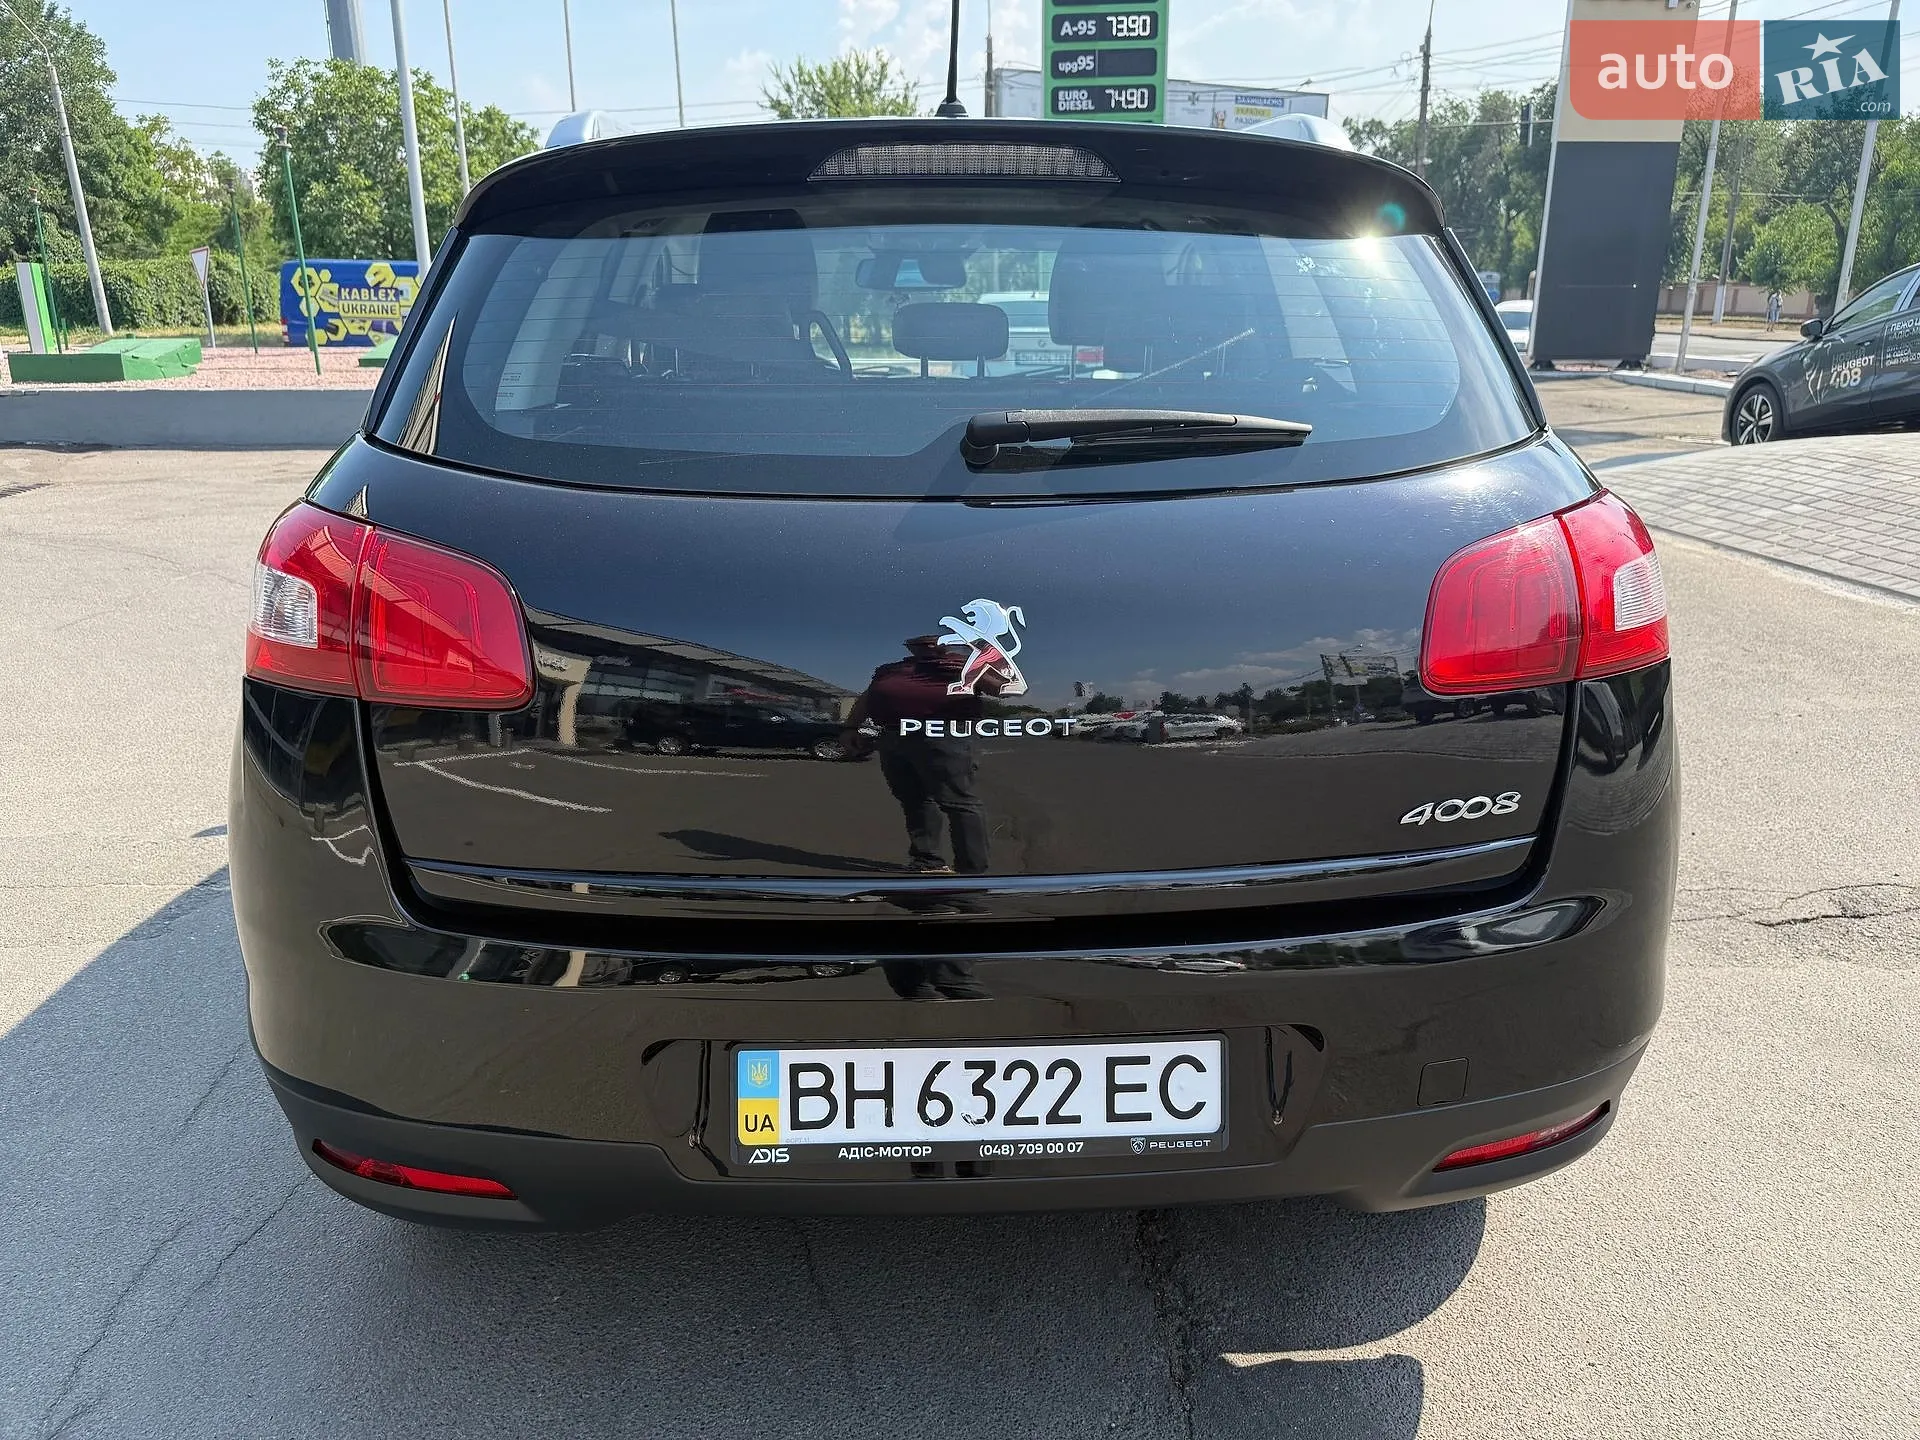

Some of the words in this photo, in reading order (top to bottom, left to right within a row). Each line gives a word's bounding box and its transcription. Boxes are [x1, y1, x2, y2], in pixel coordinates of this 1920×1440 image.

[1060, 20, 1096, 36] A-95
[1058, 55, 1095, 73] upg95
[1058, 90, 1088, 100] EURO
[1058, 100, 1095, 111] DIESEL
[341, 287, 396, 300] KABLEX
[342, 303, 397, 316] UKRAINE
[1831, 355, 1875, 373] PEUGEOT
[1829, 368, 1862, 389] 408
[900, 718, 1077, 738] PEUGEOT
[1400, 791, 1522, 826] 4008
[789, 1060, 894, 1131] BH
[917, 1057, 1082, 1127] 6322
[1105, 1054, 1207, 1123] EC
[744, 1114, 775, 1132] UA
[978, 1143, 1015, 1157] (048)
[1018, 1142, 1043, 1155] 709
[1046, 1142, 1063, 1154] 00
[1068, 1141, 1084, 1153] 07
[1149, 1139, 1212, 1149] PEUGEOT
[748, 1147, 790, 1164] ADIS
[838, 1145, 932, 1160] АДІС-МОТОР
